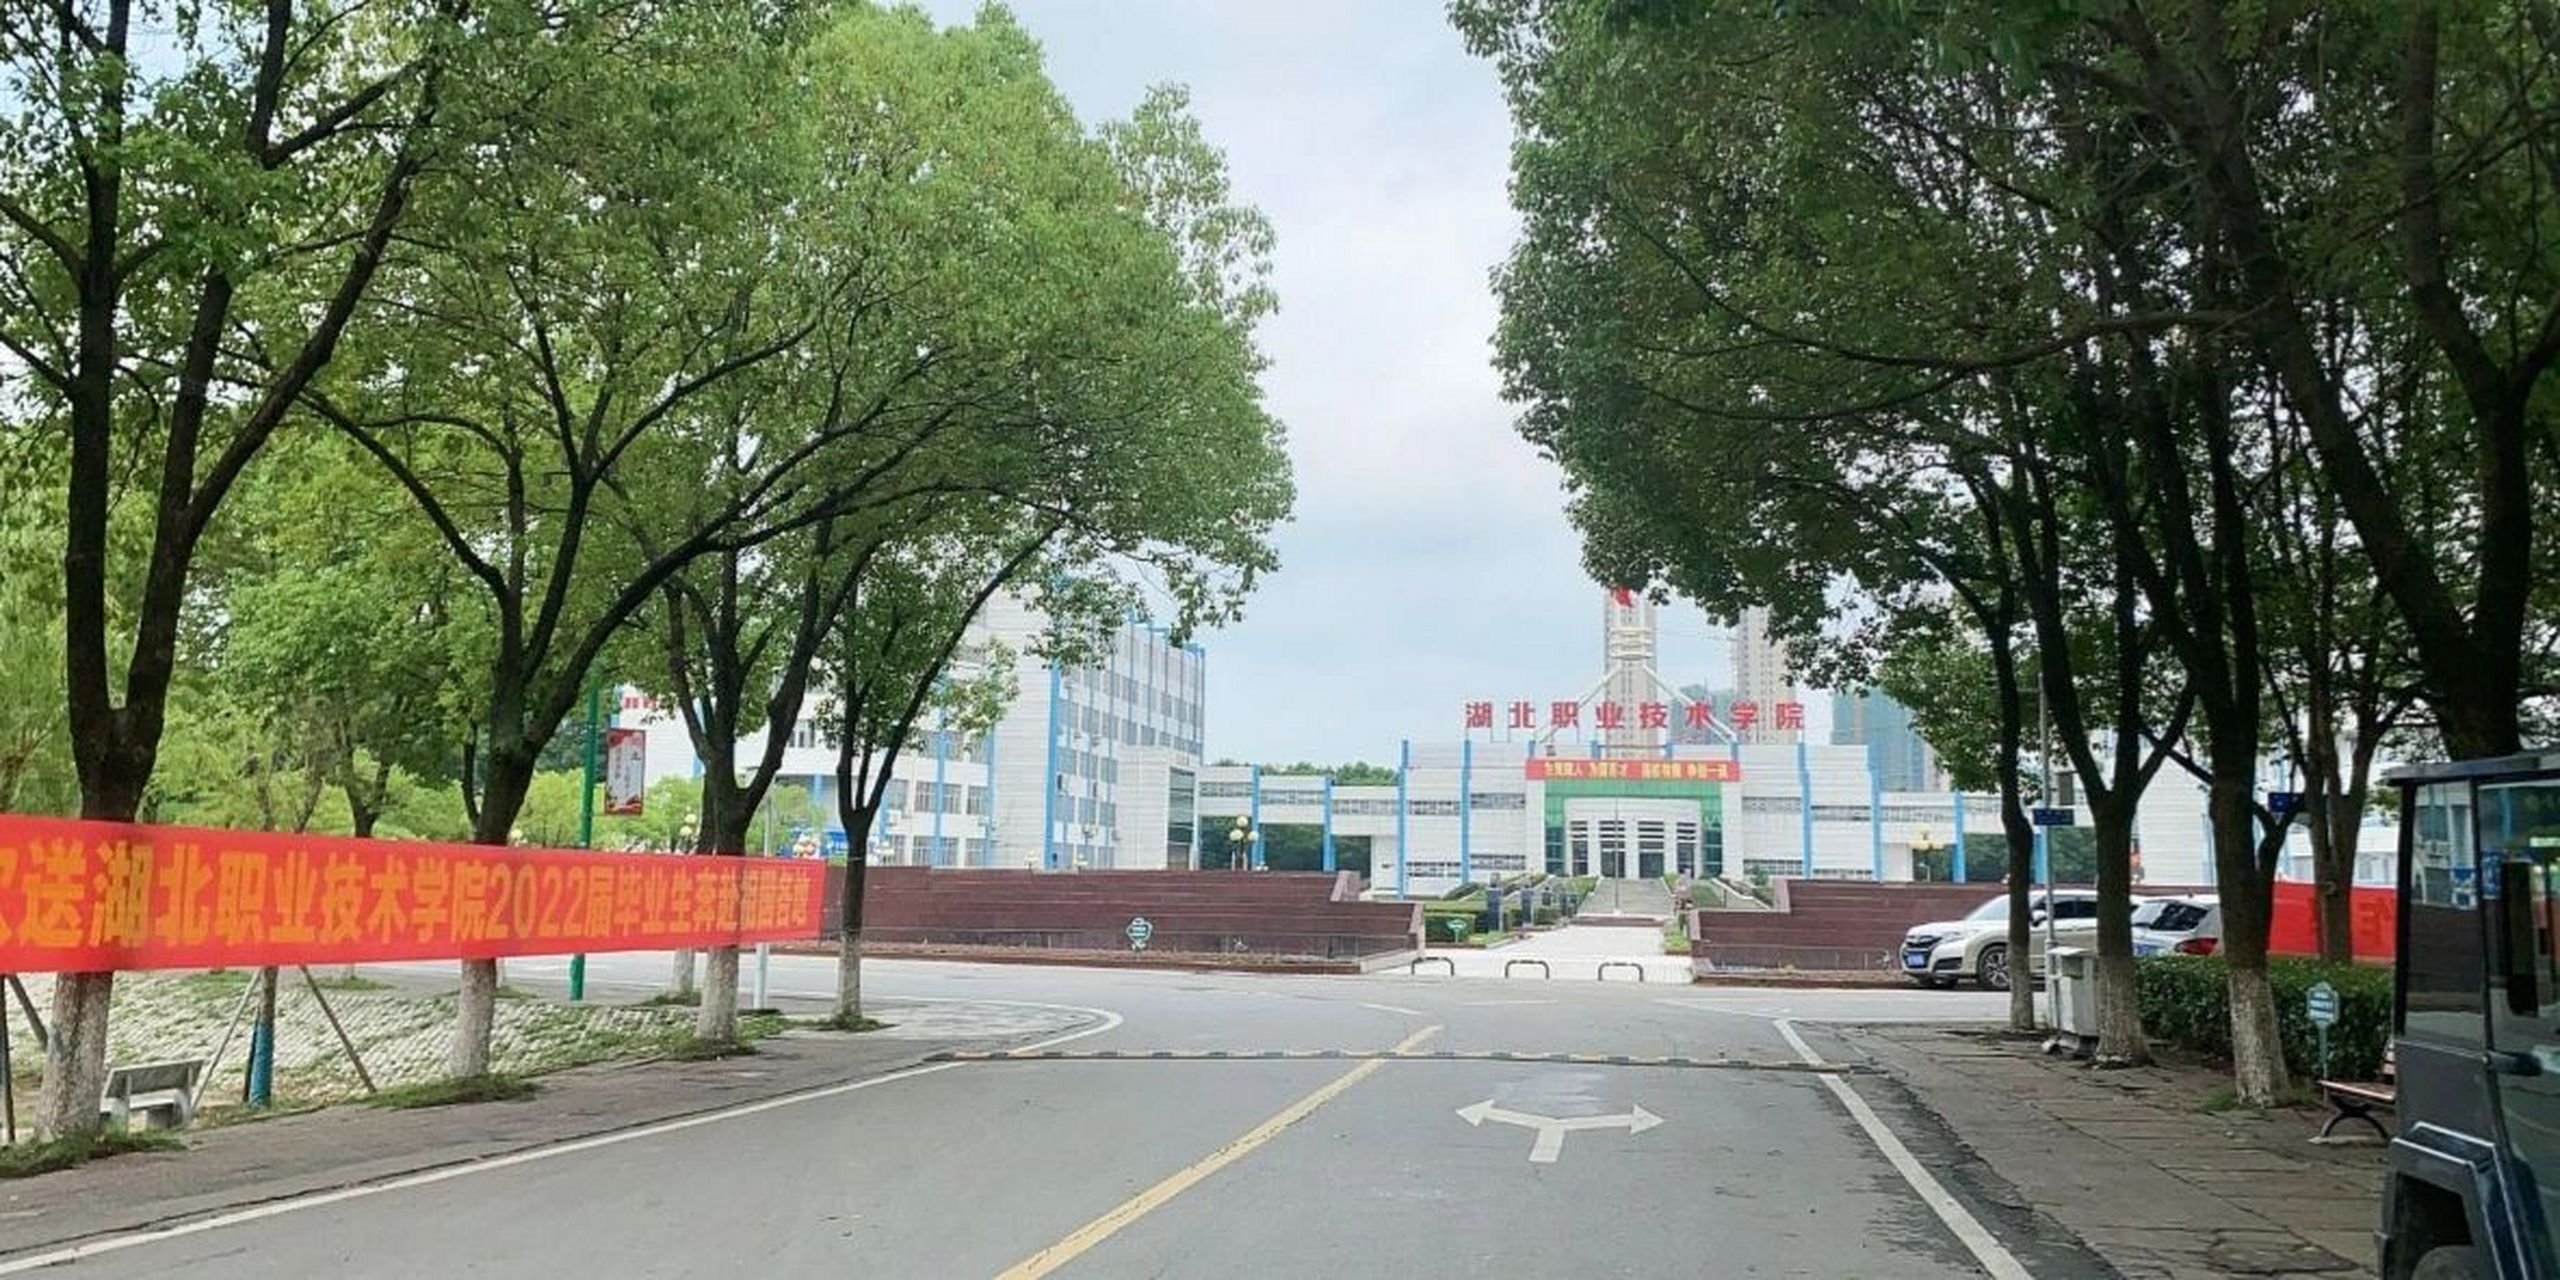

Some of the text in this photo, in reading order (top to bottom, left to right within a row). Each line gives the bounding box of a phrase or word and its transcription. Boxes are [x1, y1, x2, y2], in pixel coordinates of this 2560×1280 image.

[1465, 701, 1805, 729] 湖北职业技术学院
[0, 837, 810, 948] 送湖北职业技术学院2022届毕业生奔赴祖国各地
